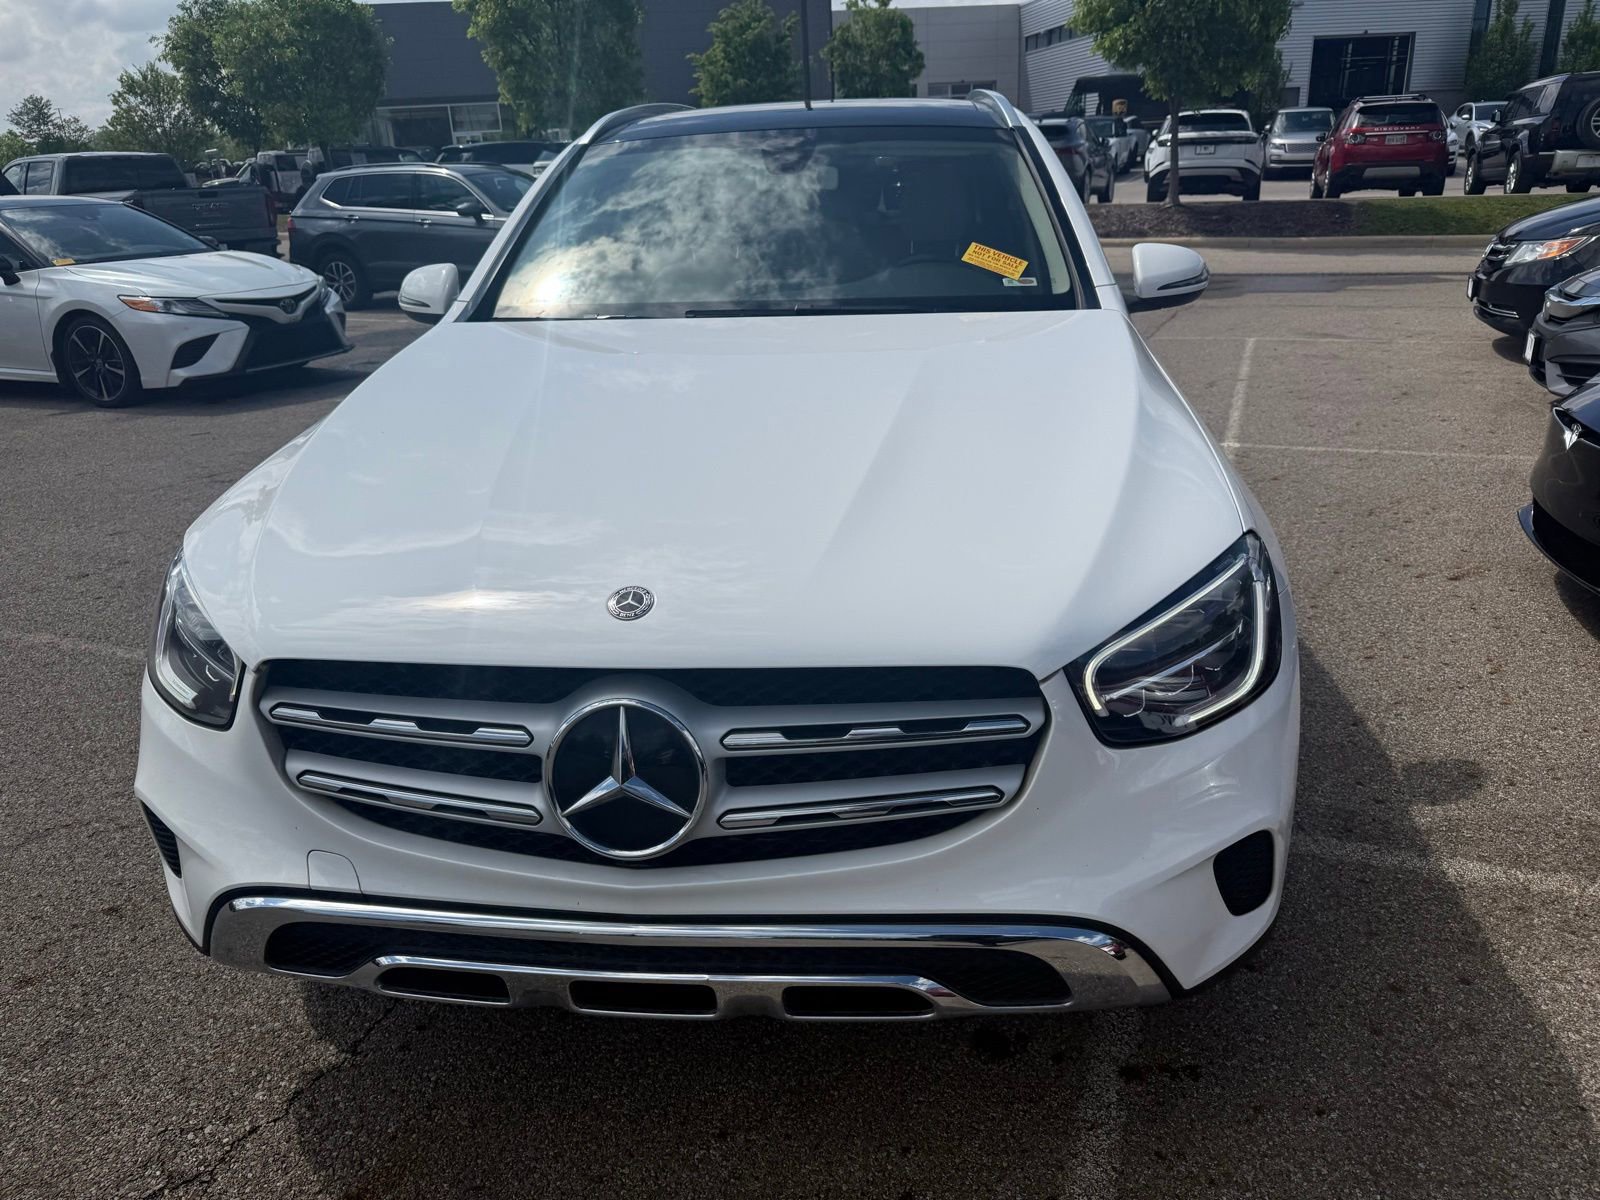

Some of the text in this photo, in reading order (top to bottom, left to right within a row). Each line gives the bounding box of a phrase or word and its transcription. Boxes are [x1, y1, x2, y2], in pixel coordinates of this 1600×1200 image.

[974, 244, 991, 254] THIS
[992, 249, 1024, 266] VEHICLE
[987, 254, 1001, 263] FOR
[1002, 260, 1020, 269] SALE
